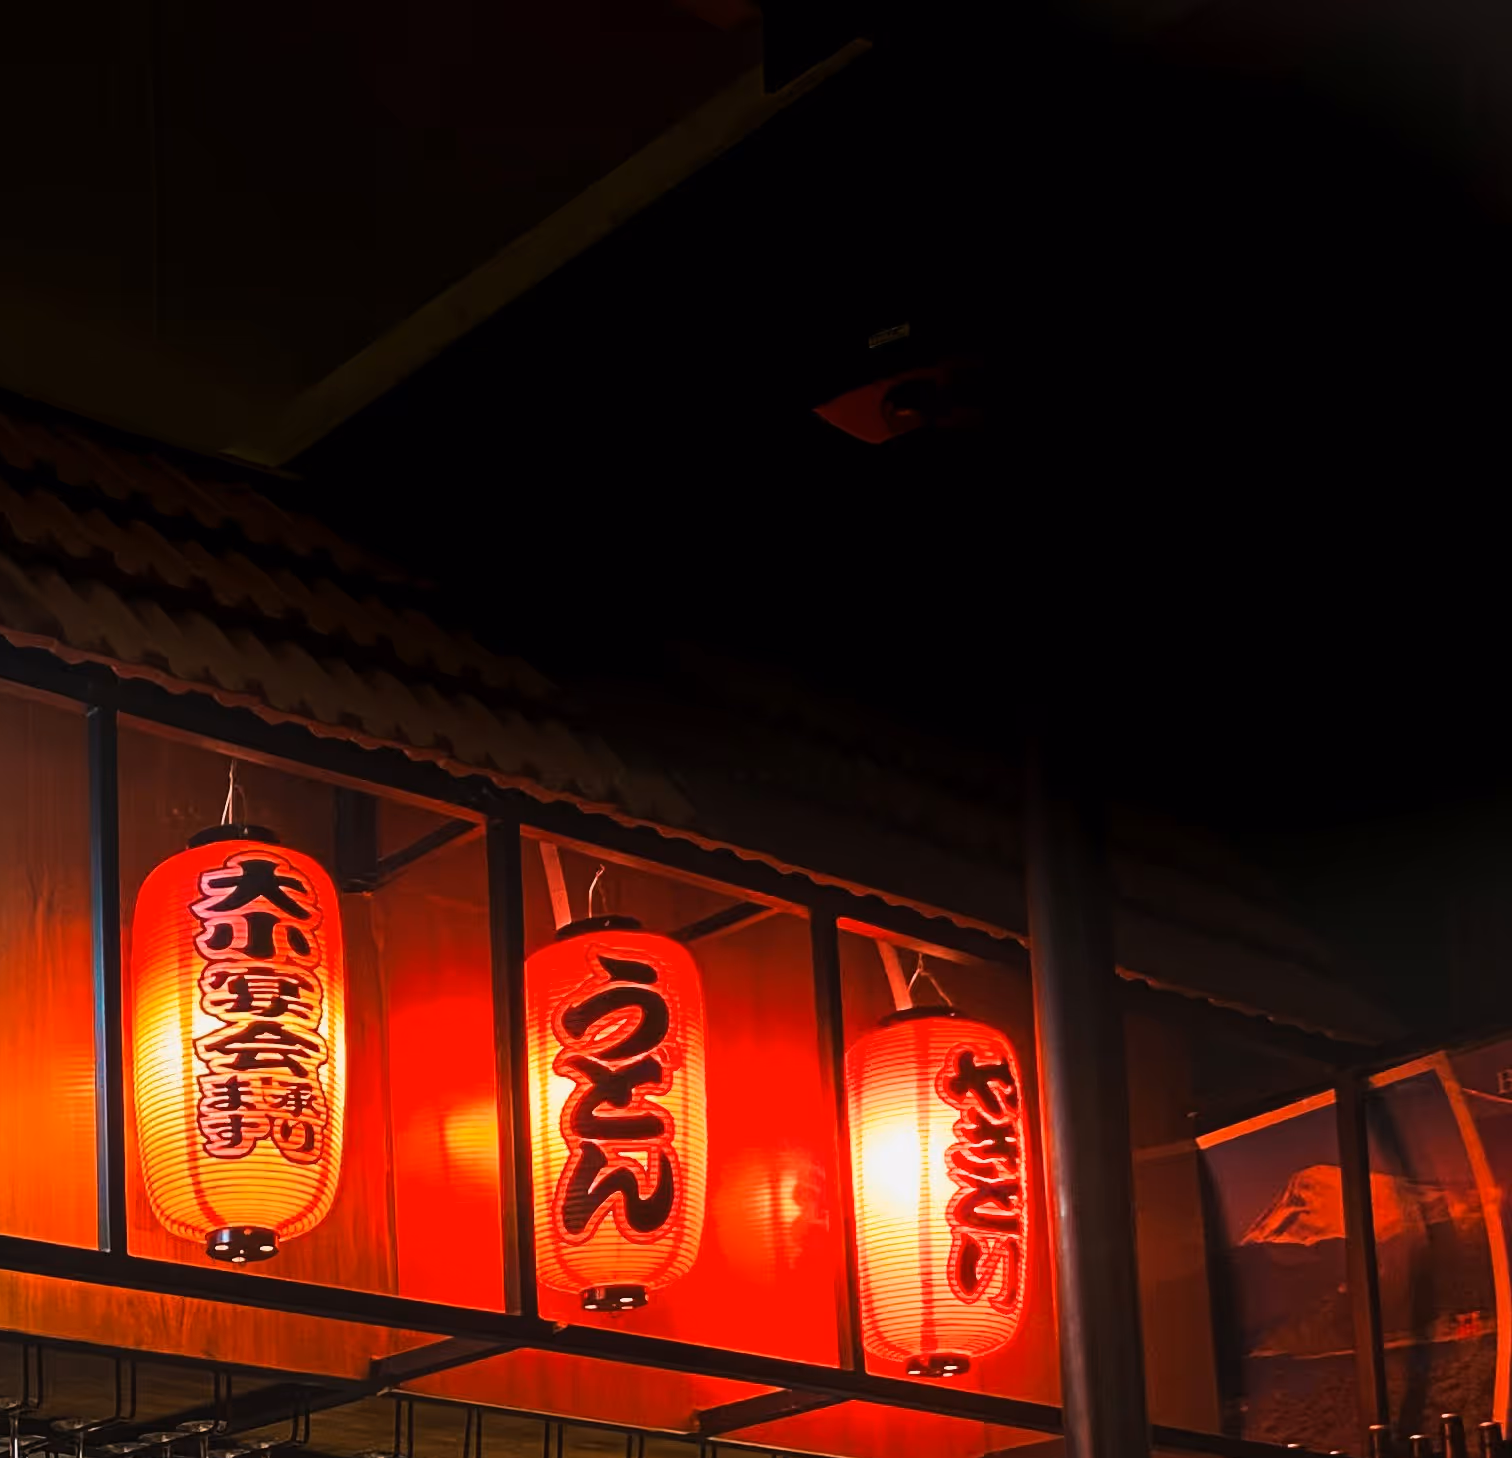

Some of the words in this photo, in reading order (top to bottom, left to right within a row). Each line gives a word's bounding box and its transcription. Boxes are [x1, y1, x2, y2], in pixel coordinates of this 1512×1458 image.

[202, 858, 321, 1078] 大小宴会
[562, 957, 673, 1235] うどん
